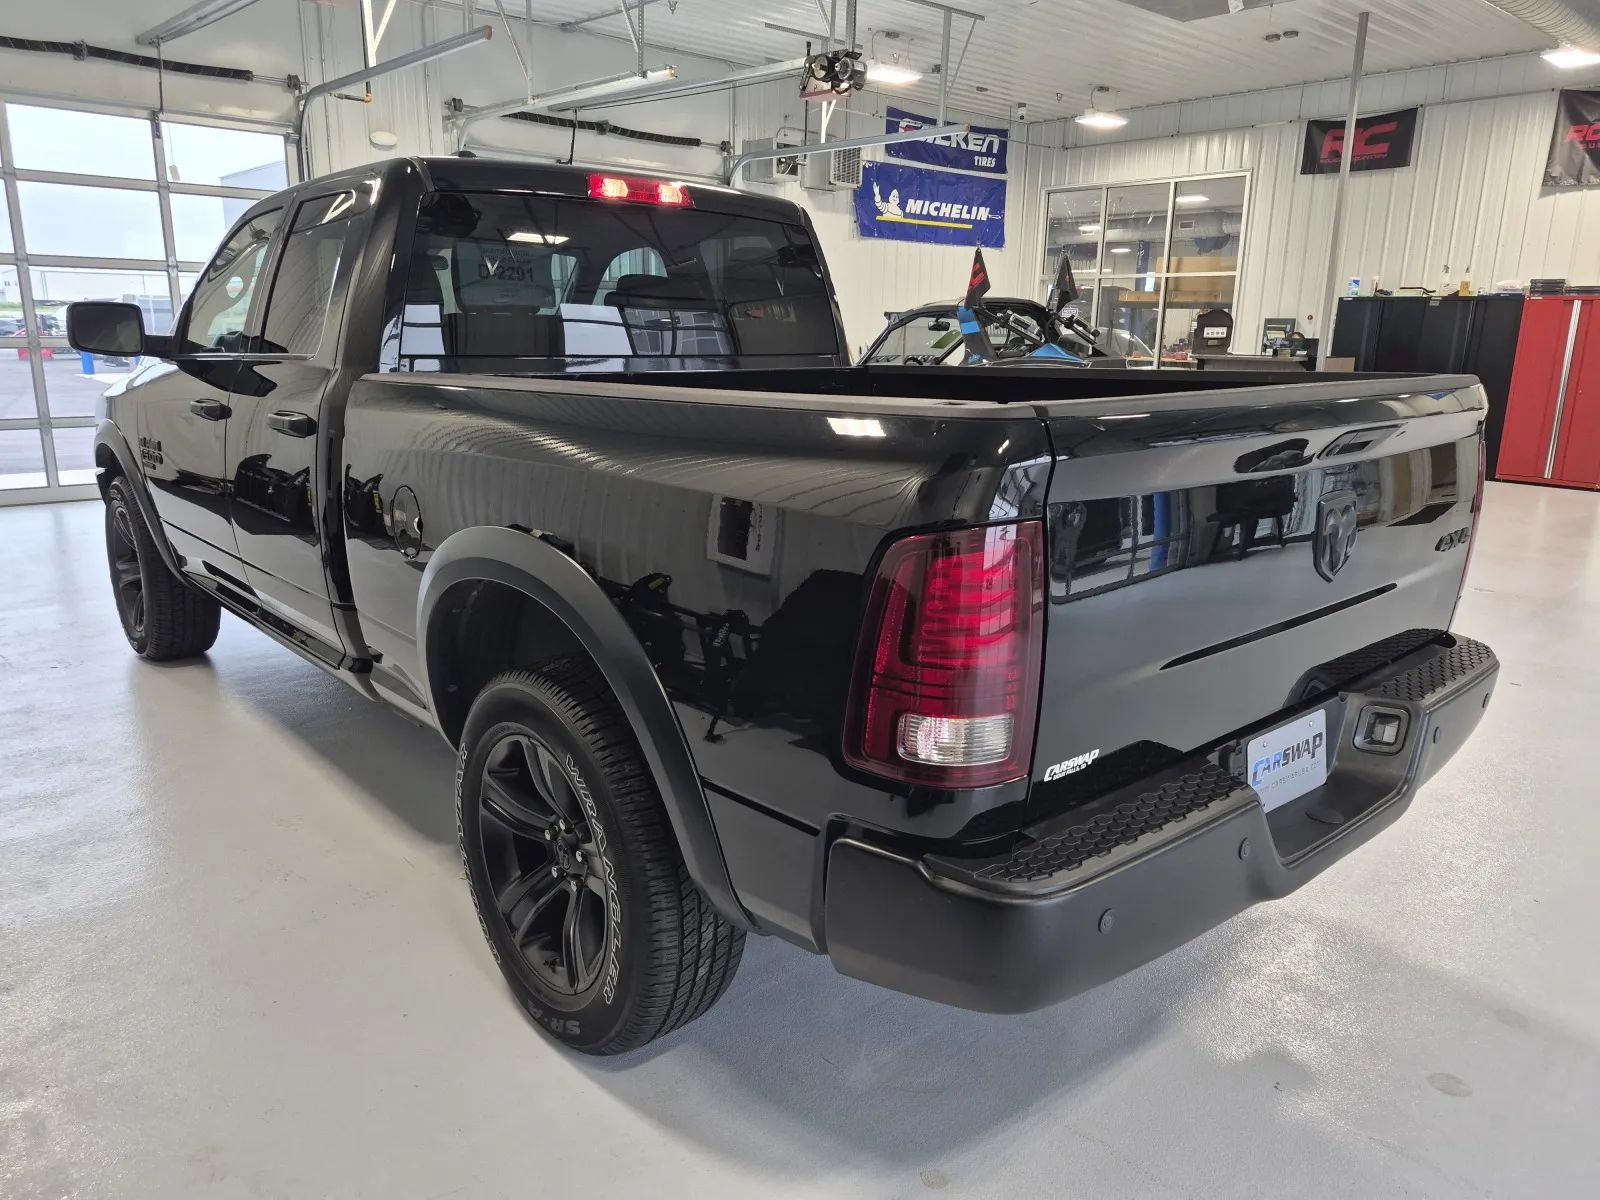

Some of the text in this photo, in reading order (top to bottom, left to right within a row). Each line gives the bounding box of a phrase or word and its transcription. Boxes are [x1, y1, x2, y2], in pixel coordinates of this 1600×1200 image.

[974, 155, 996, 168] TIRES
[905, 198, 991, 221] MICHELIN
[1044, 748, 1100, 782] CARSWAP
[1252, 732, 1323, 787] CARSWAP
[565, 752, 623, 1005] WRANGLER
